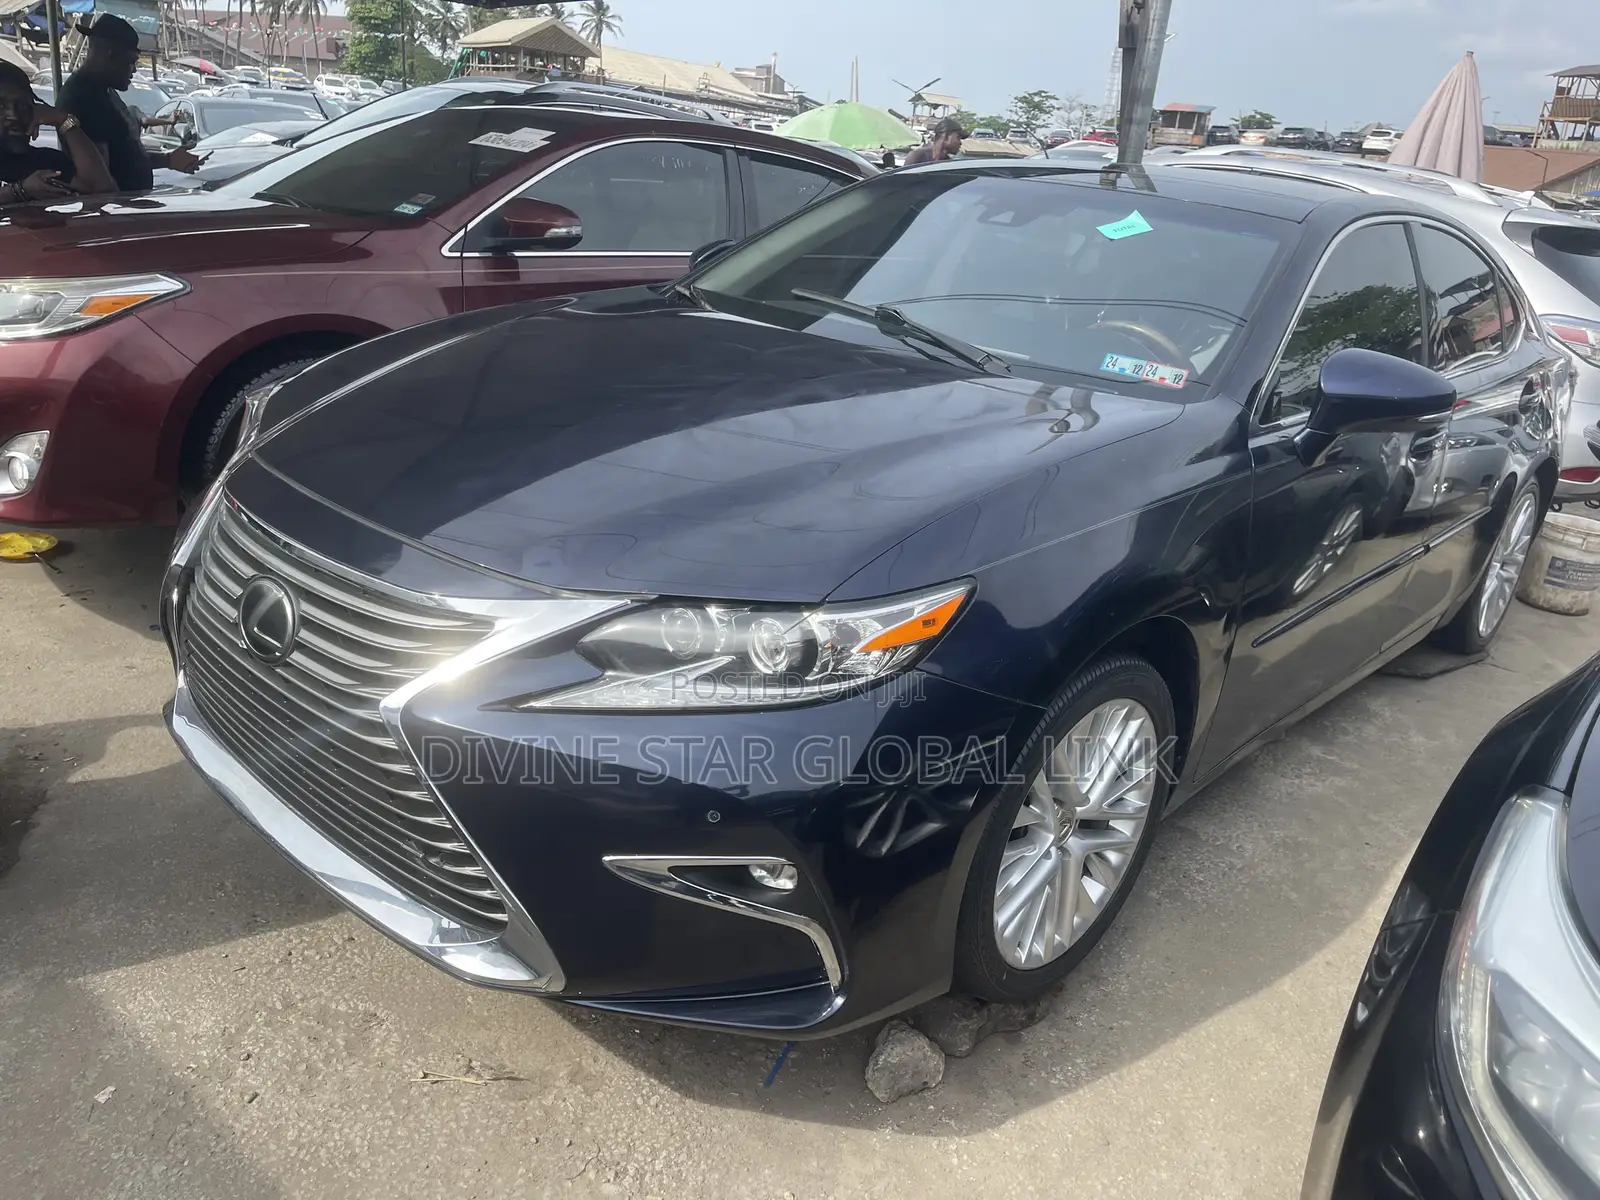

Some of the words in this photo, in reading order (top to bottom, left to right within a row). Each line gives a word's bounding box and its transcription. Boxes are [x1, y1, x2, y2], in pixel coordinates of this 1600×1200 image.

[1105, 356, 1119, 369] 24
[1132, 364, 1144, 376] 12
[1145, 364, 1159, 378] 24
[1172, 373, 1184, 386] 12
